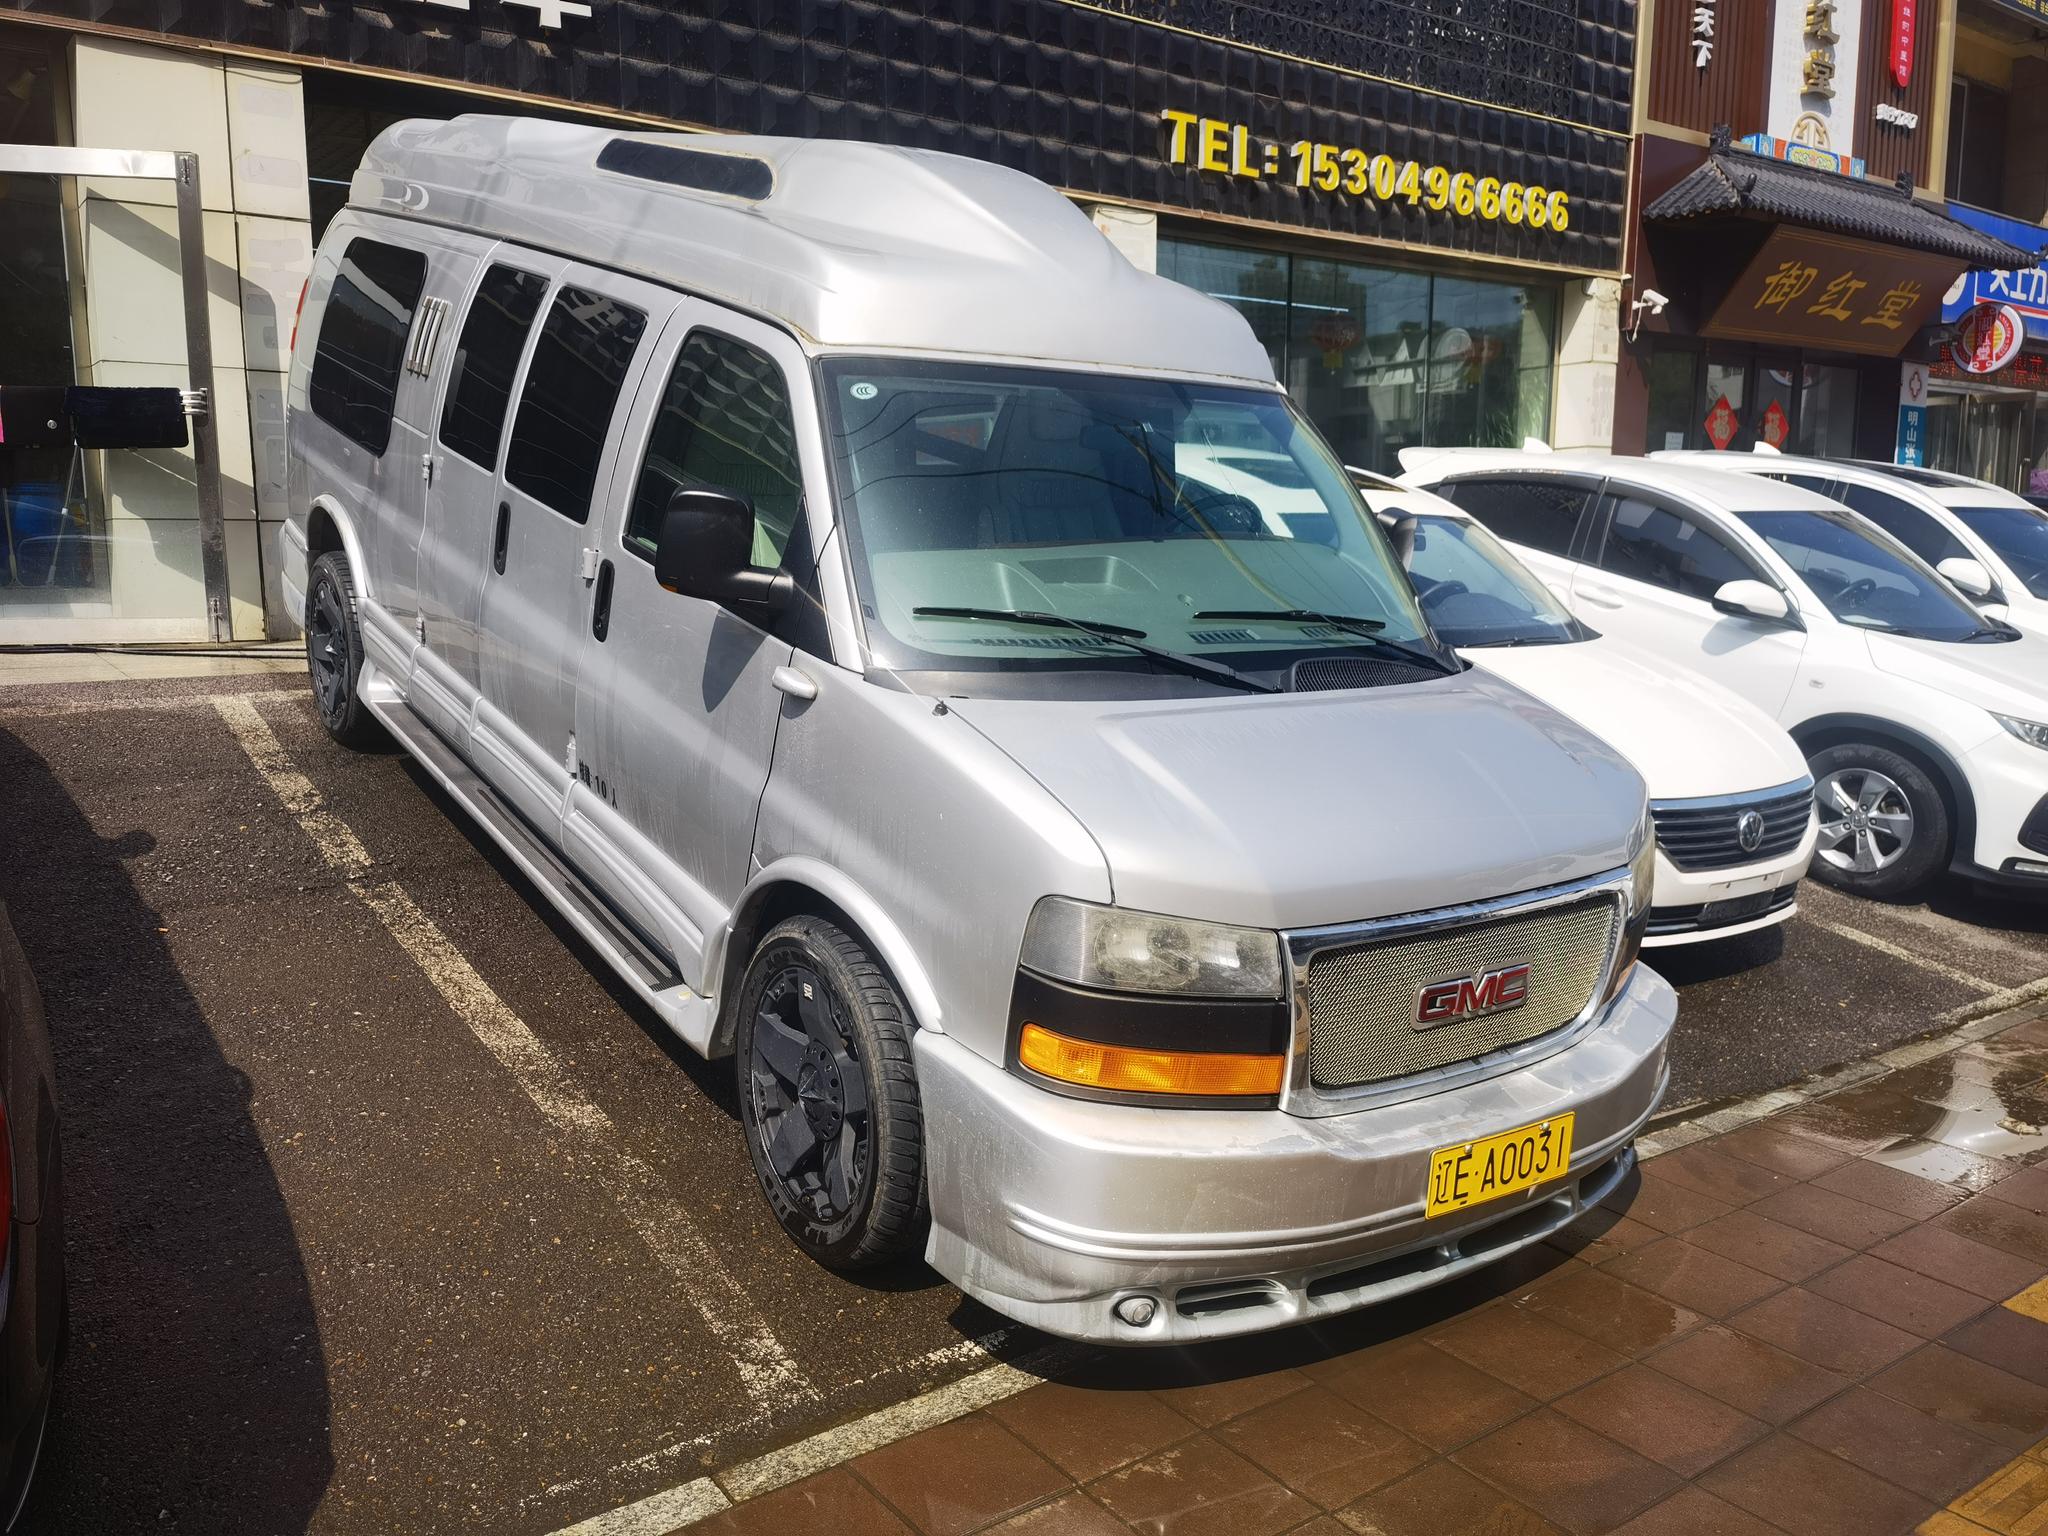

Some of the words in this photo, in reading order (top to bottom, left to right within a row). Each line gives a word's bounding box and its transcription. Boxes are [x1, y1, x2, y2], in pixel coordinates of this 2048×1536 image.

[1692, 0, 1716, 68] 天下
[1161, 109, 1278, 180] TEL:
[1290, 139, 1570, 233] 15304966666
[1754, 260, 1922, 330] 御红堂
[1416, 962, 1532, 1023] GMC
